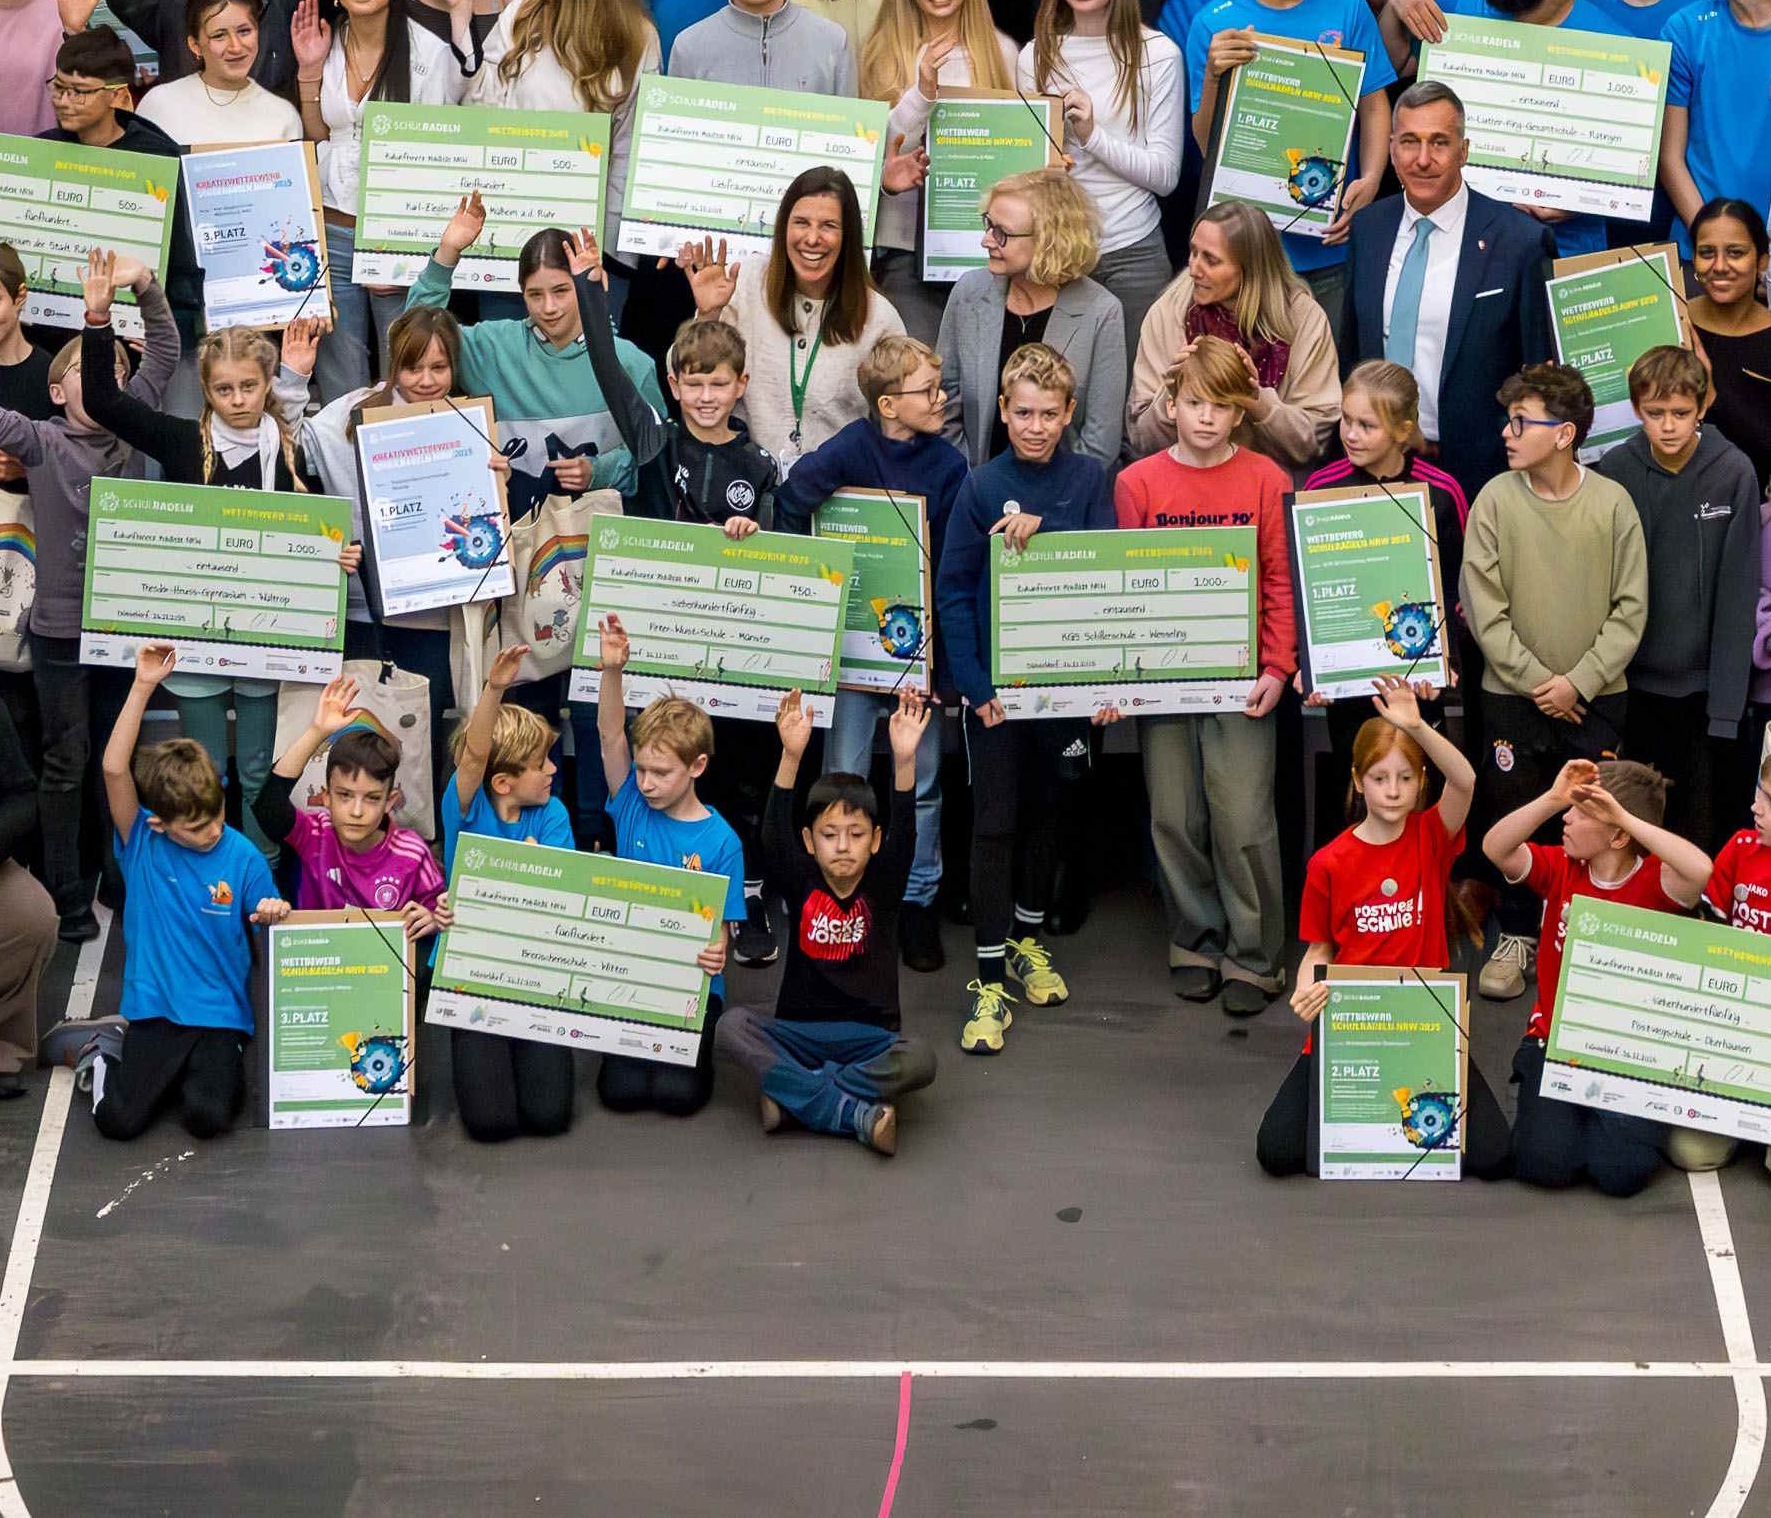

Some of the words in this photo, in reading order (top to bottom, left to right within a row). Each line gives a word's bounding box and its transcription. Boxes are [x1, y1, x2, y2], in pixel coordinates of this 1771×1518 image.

[1549, 74, 1575, 86] EURO
[1238, 113, 1244, 123] 1.
[1245, 114, 1279, 130] PLATZ
[765, 135, 793, 148] EURO
[491, 155, 517, 166] EURO
[552, 159, 578, 170] 500,-
[936, 177, 943, 187] 1.
[945, 177, 976, 188] PLATZ
[56, 190, 83, 203] EURO
[204, 230, 214, 241] 3.
[215, 227, 246, 240] PLATZ
[122, 498, 194, 513] SCHULRADELN
[380, 508, 387, 517] 1.
[389, 501, 423, 516] PLATZ
[1155, 511, 1228, 526] Bonjour
[226, 537, 254, 549] EURO
[621, 536, 695, 552] SCHULRADELN
[1023, 548, 1097, 562] SCHULRADELN
[723, 577, 752, 590] EURO
[1131, 578, 1159, 589] EURO
[1312, 588, 1320, 598] 1.
[1322, 584, 1356, 597] PLATZ
[488, 856, 563, 879] SCHULRADELN
[592, 906, 621, 920] EURO
[808, 927, 864, 944] JONES
[1601, 921, 1678, 947] SCHULRADELN
[281, 956, 341, 967] WETTBEWERB
[1708, 978, 1739, 994] EURO
[281, 1012, 291, 1024] 3.
[293, 1011, 329, 1023] PLATZ
[1331, 1012, 1392, 1022] WETTBEWERB
[1331, 1066, 1342, 1077] 2.
[1344, 1066, 1380, 1077] PLATZ
